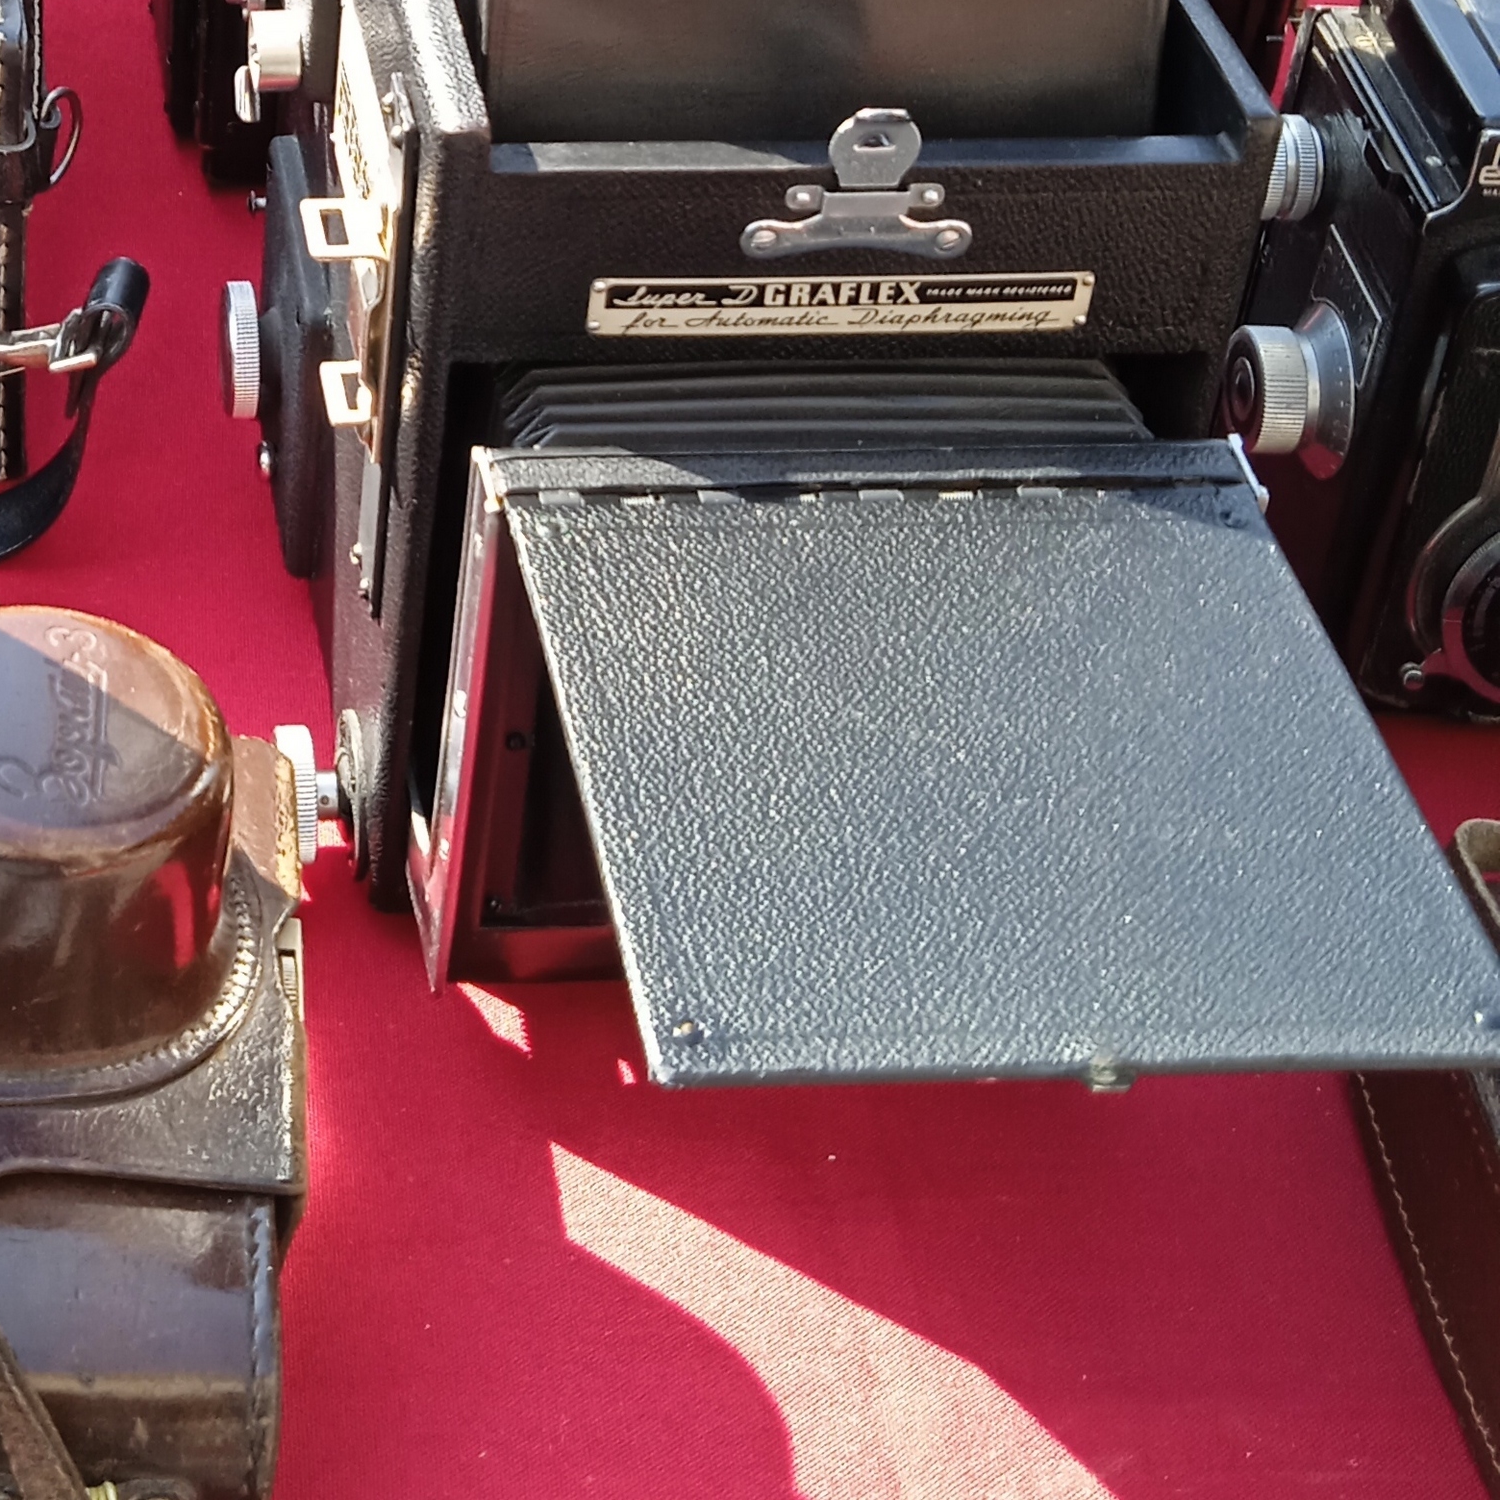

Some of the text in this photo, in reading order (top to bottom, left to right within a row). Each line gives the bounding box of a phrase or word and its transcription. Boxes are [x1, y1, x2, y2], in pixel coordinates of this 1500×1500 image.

[613, 285, 717, 308] Super
[721, 285, 759, 306] D
[763, 282, 922, 306] GRAFLEX
[620, 306, 1060, 334] for Automatic Diaphragming
